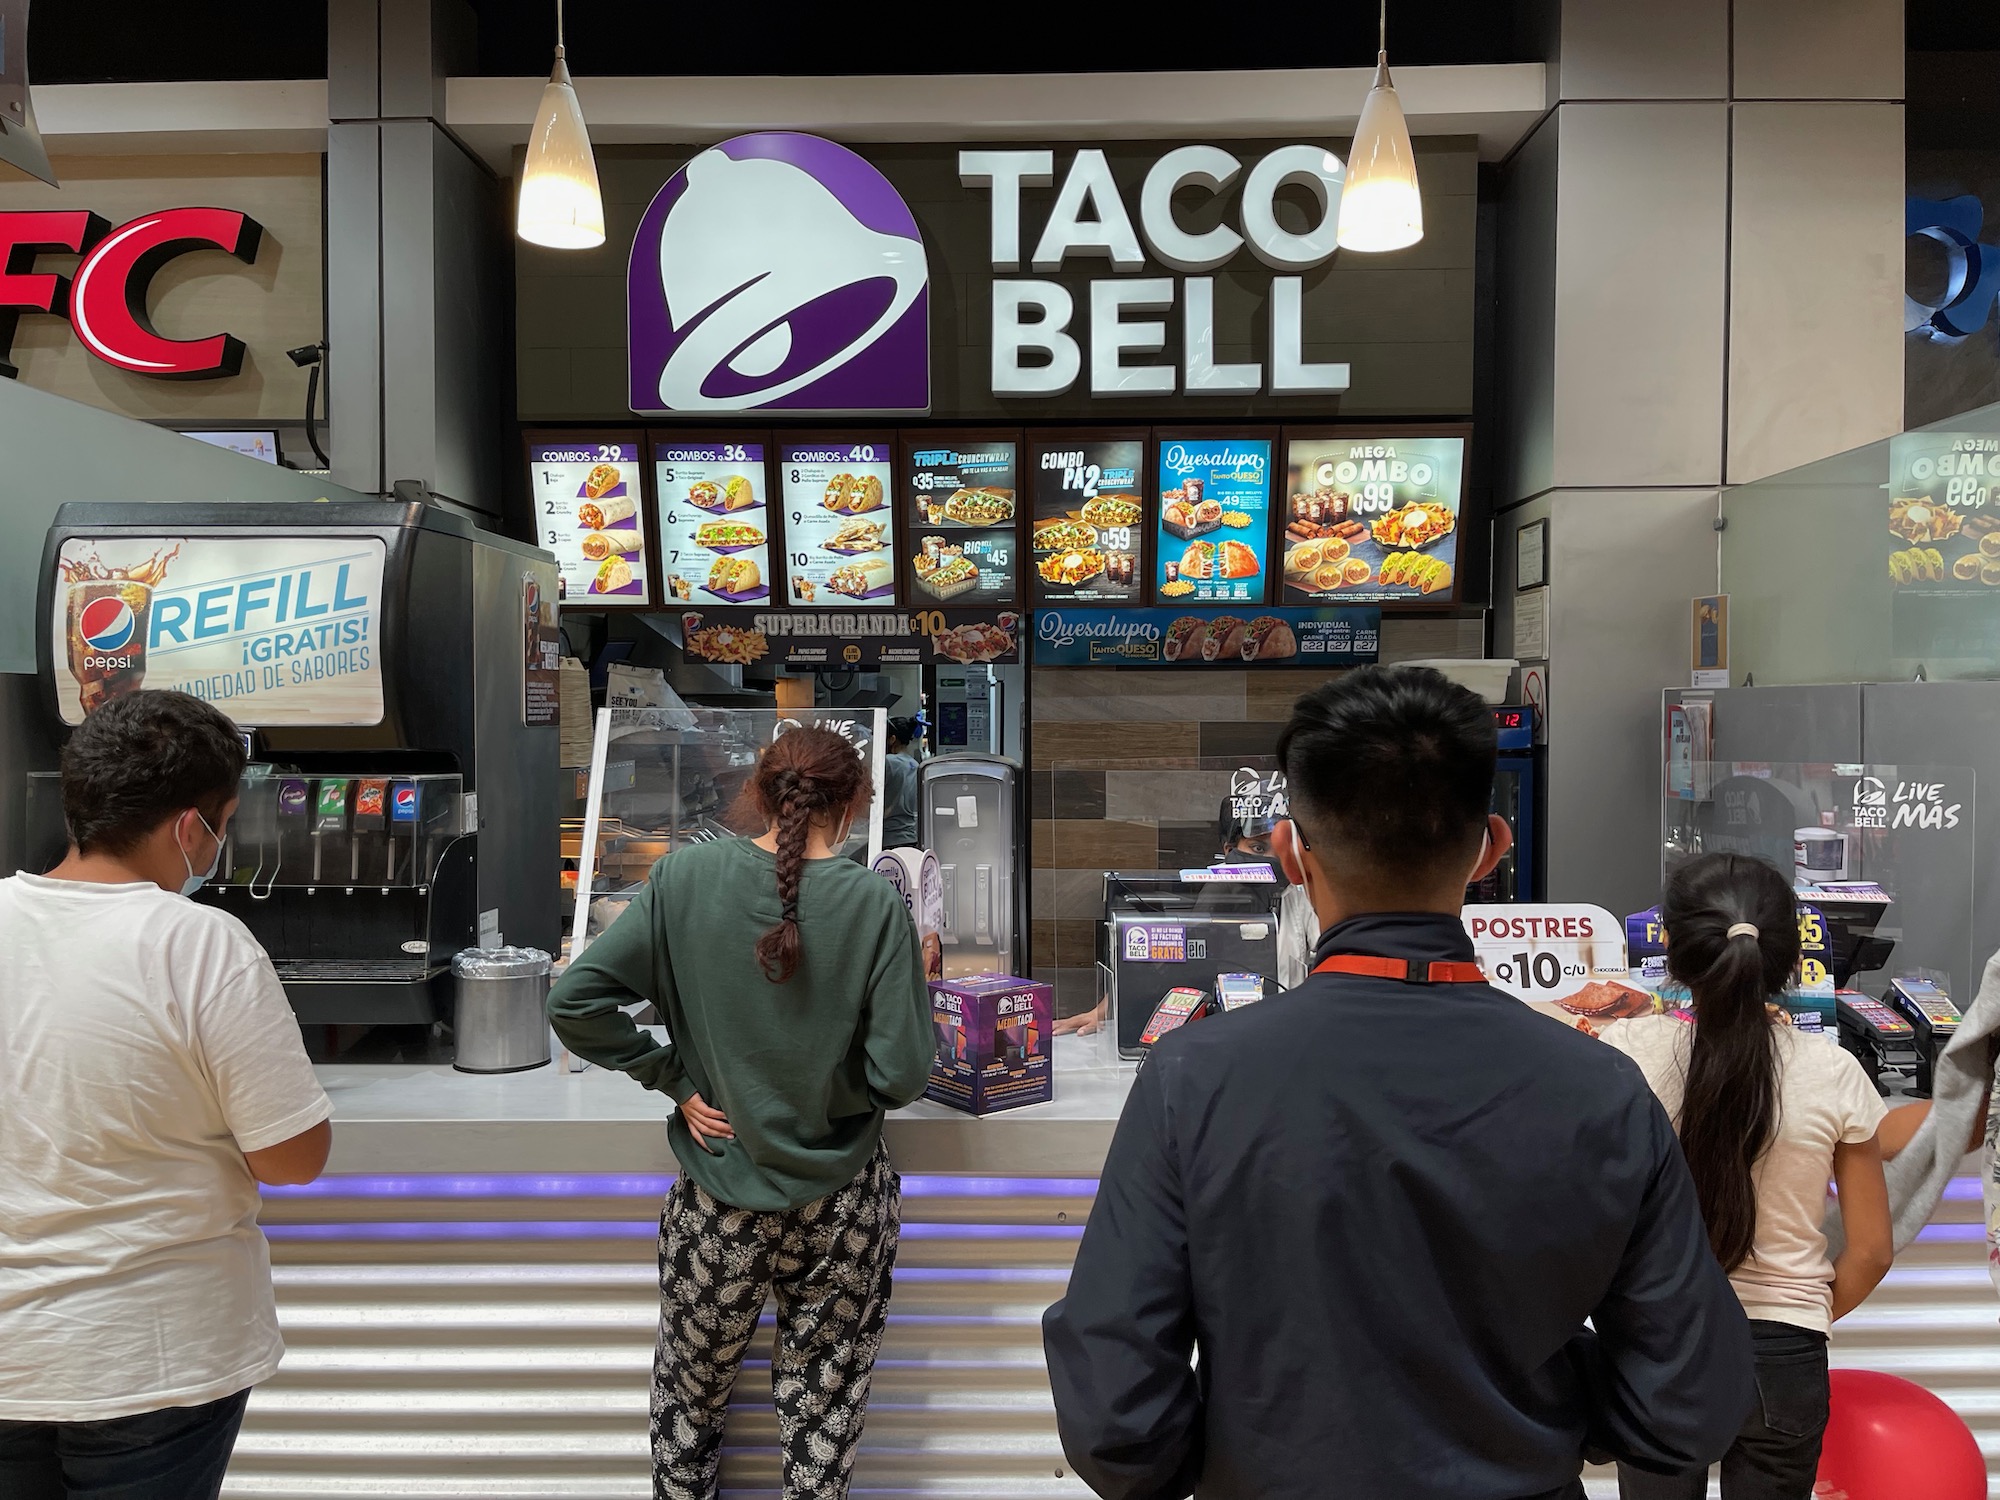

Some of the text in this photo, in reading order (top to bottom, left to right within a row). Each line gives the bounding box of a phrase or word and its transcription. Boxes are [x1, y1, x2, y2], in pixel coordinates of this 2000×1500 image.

[958, 145, 1347, 271] TACO
[0, 207, 262, 380] FC
[991, 276, 1351, 398] BELL
[542, 451, 590, 462] COMBOS
[667, 450, 716, 461] COMBOS
[792, 451, 840, 462] COMBOS
[913, 451, 1009, 467] TRIPLE CRUNCHYWRAP
[1349, 446, 1397, 459] MEGA
[1041, 451, 1084, 470] COMBO
[1165, 444, 1265, 476] Quesalupa
[543, 471, 549, 485] 1
[666, 468, 675, 482] 5
[791, 469, 800, 483] 8
[1103, 469, 1135, 479] TRIPLE
[1230, 472, 1260, 480] QUESO
[1316, 460, 1433, 486] COMBO
[912, 472, 934, 490] Q35
[1352, 483, 1394, 515] Q99
[545, 501, 555, 515] 2
[667, 511, 677, 524] 6
[792, 511, 802, 525] 9
[548, 530, 557, 544] 3
[1102, 527, 1130, 550] Q59
[963, 541, 981, 554] BIG
[670, 550, 679, 564] 7
[790, 553, 808, 566] 10
[987, 549, 1008, 566] Q45
[149, 563, 368, 648] REFILL
[754, 613, 911, 637] SUPERAGRANDA
[1038, 611, 1160, 648] Quesalupa
[1298, 621, 1351, 629] INDIVIDUAL
[242, 617, 370, 666] ¡GRATIS!
[1116, 644, 1156, 655] QUESO
[84, 654, 132, 670] pepsi
[263, 663, 285, 690] DE
[292, 646, 370, 684] SABORES
[611, 696, 637, 707] SEE YOU
[1229, 797, 1262, 808] TACO
[1232, 808, 1262, 819] BELL
[1852, 806, 1887, 818] TACO
[1892, 799, 1961, 830] MÁS
[1854, 817, 1886, 828] BELL
[1471, 917, 1594, 938] POSTRES
[1151, 946, 1184, 960] GRATIS
[1641, 957, 1648, 968] 2
[1496, 952, 1561, 989] Q10
[1563, 965, 1585, 976] C/U
[945, 993, 962, 1004] TACO
[1013, 993, 1034, 1003] TACO
[946, 1002, 962, 1013] BELL
[1014, 1002, 1034, 1013] BELL
[1792, 1014, 1799, 1024] 2
